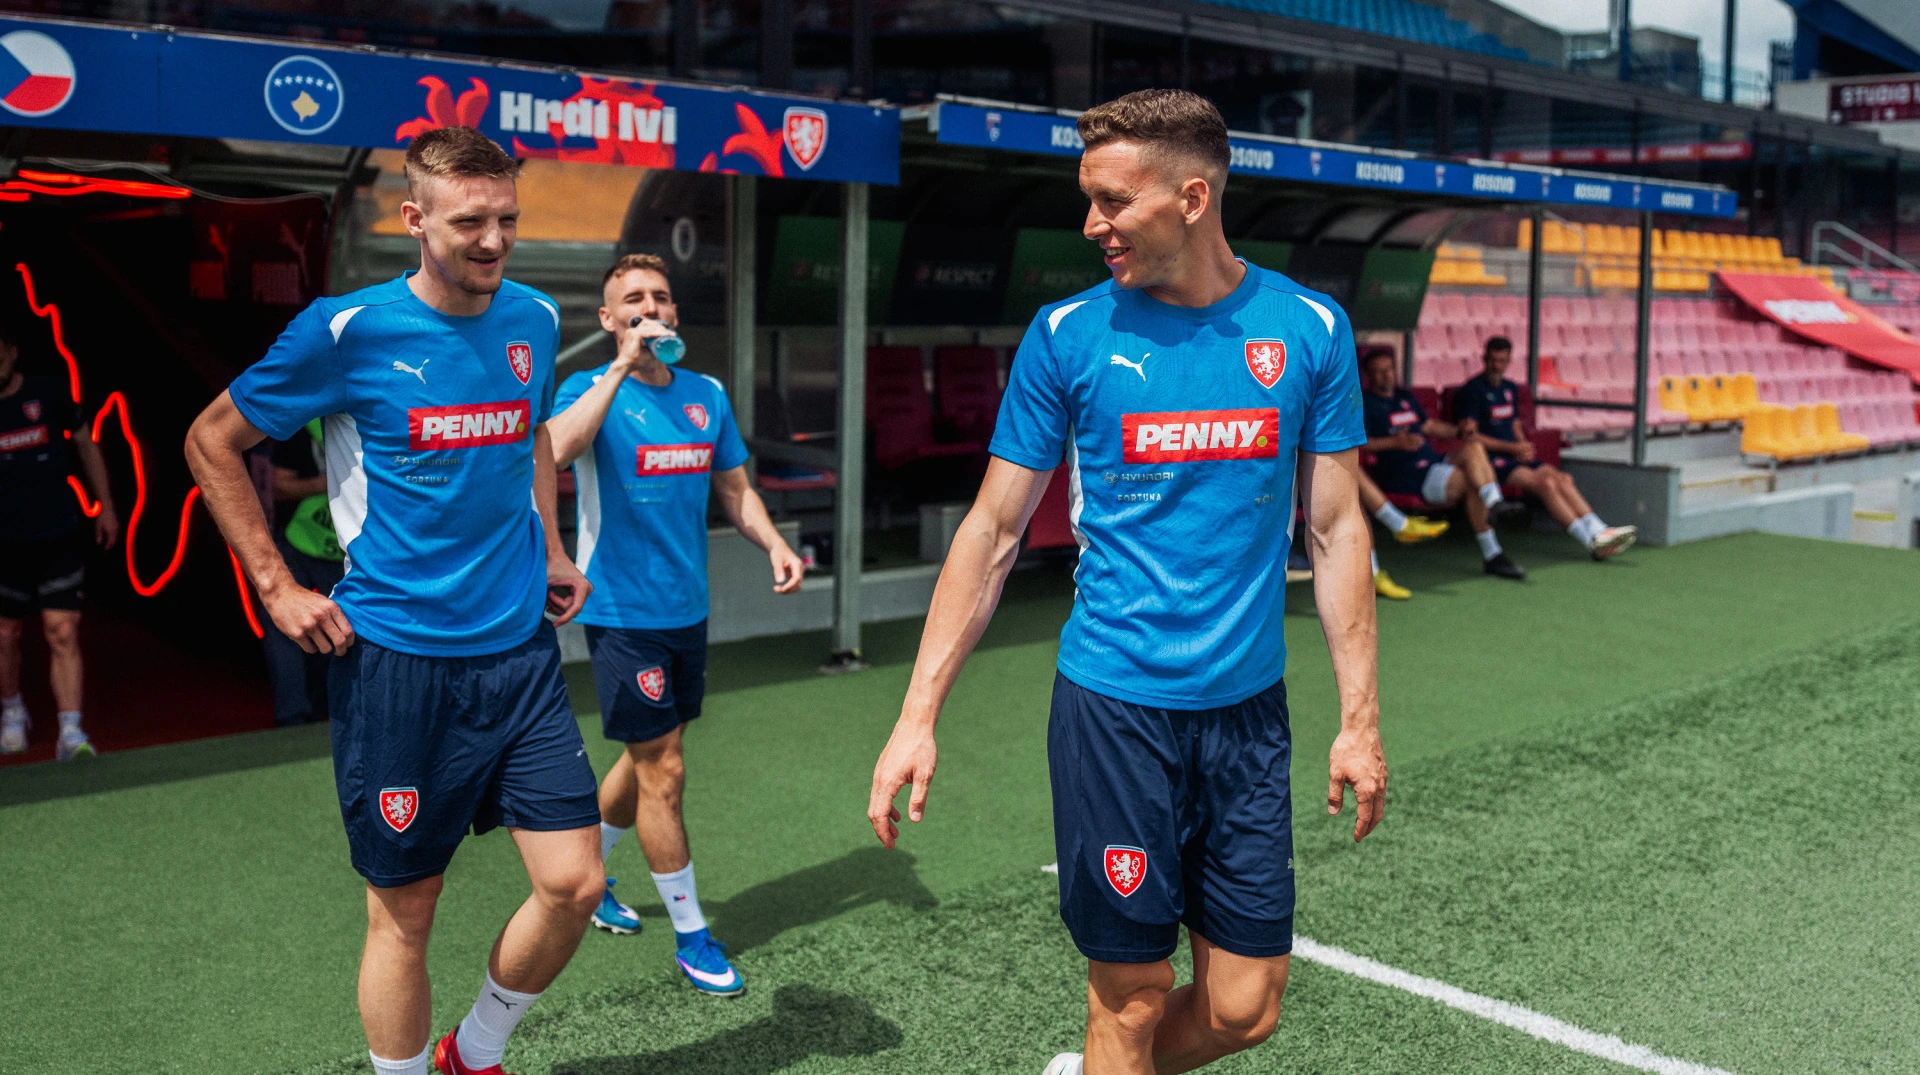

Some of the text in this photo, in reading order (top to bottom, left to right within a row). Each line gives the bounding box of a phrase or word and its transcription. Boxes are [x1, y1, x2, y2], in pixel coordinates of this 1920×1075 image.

[500, 90, 678, 145] Hrdí lvi
[1051, 124, 1085, 149] KOS
[1356, 160, 1404, 184] KOSOVO
[1473, 173, 1516, 194] KOSOVO
[0, 429, 41, 450] ENNY
[412, 458, 461, 466] HYUNDAI
[405, 475, 449, 484] FORTUNA
[1121, 471, 1174, 482] HYUNDAI
[1117, 493, 1162, 502] FORTUNA
